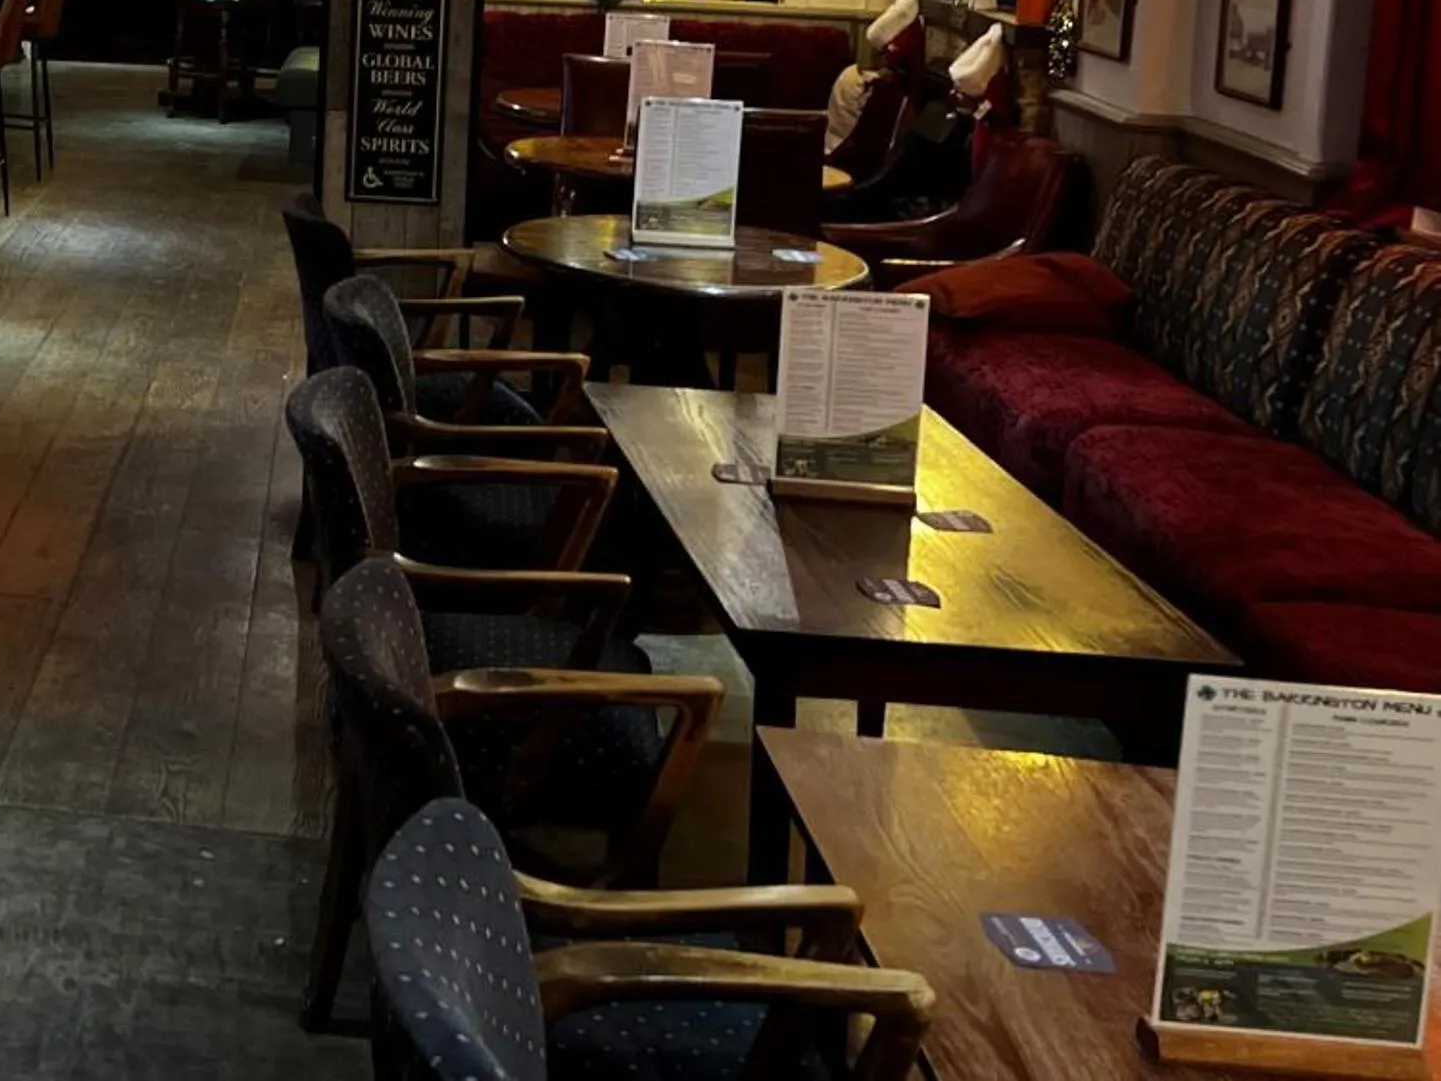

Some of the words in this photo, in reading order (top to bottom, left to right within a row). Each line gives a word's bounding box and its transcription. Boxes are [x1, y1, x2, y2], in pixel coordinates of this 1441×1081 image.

[368, 23, 433, 41] WINES
[362, 52, 435, 70] GLOBAL
[370, 70, 426, 86] BEERS
[360, 136, 430, 155] SPIRITS
[1222, 687, 1257, 701] THE
[1382, 698, 1432, 716] MENU
